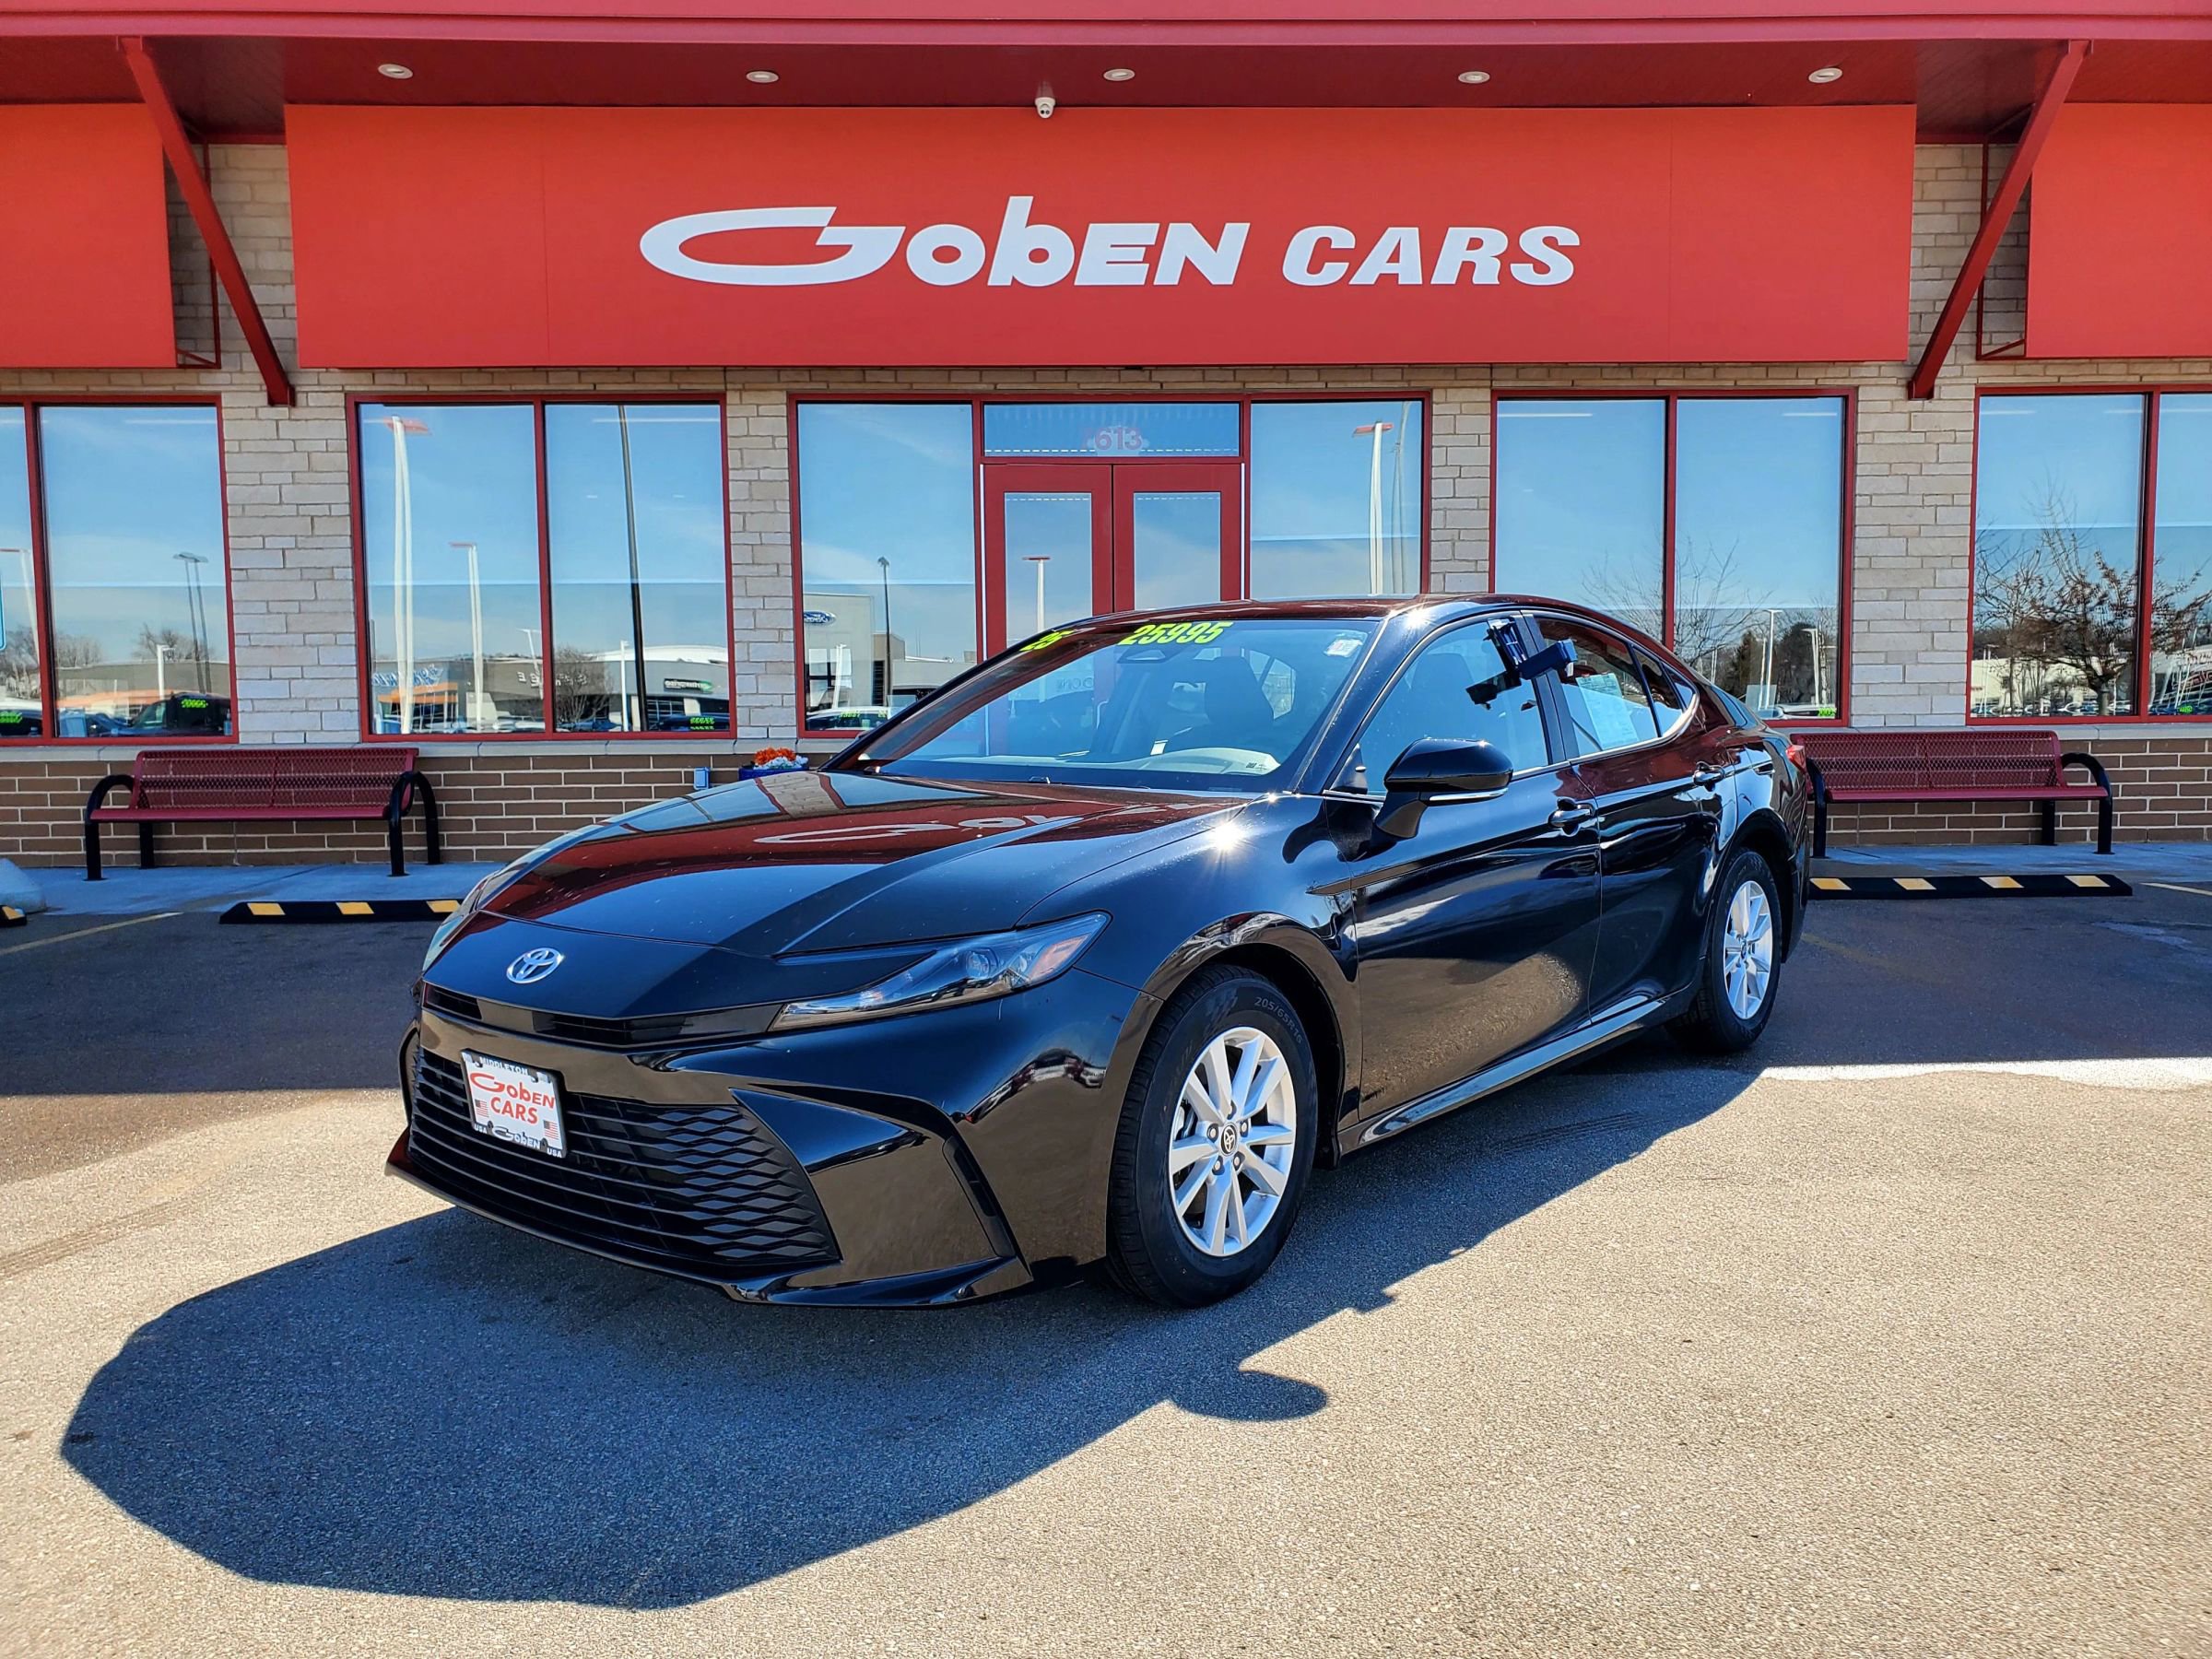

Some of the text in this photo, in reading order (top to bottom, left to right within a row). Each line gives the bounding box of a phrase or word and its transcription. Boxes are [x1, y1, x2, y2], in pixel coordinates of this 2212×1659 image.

[1282, 225, 1580, 286] CARS
[1117, 621, 1234, 646] 25995
[1253, 996, 1303, 1043] 205/65R16
[479, 1055, 529, 1075] MIDDLETON
[490, 1096, 538, 1124] CARS
[474, 1123, 488, 1135] USA
[547, 1147, 562, 1159] USA
